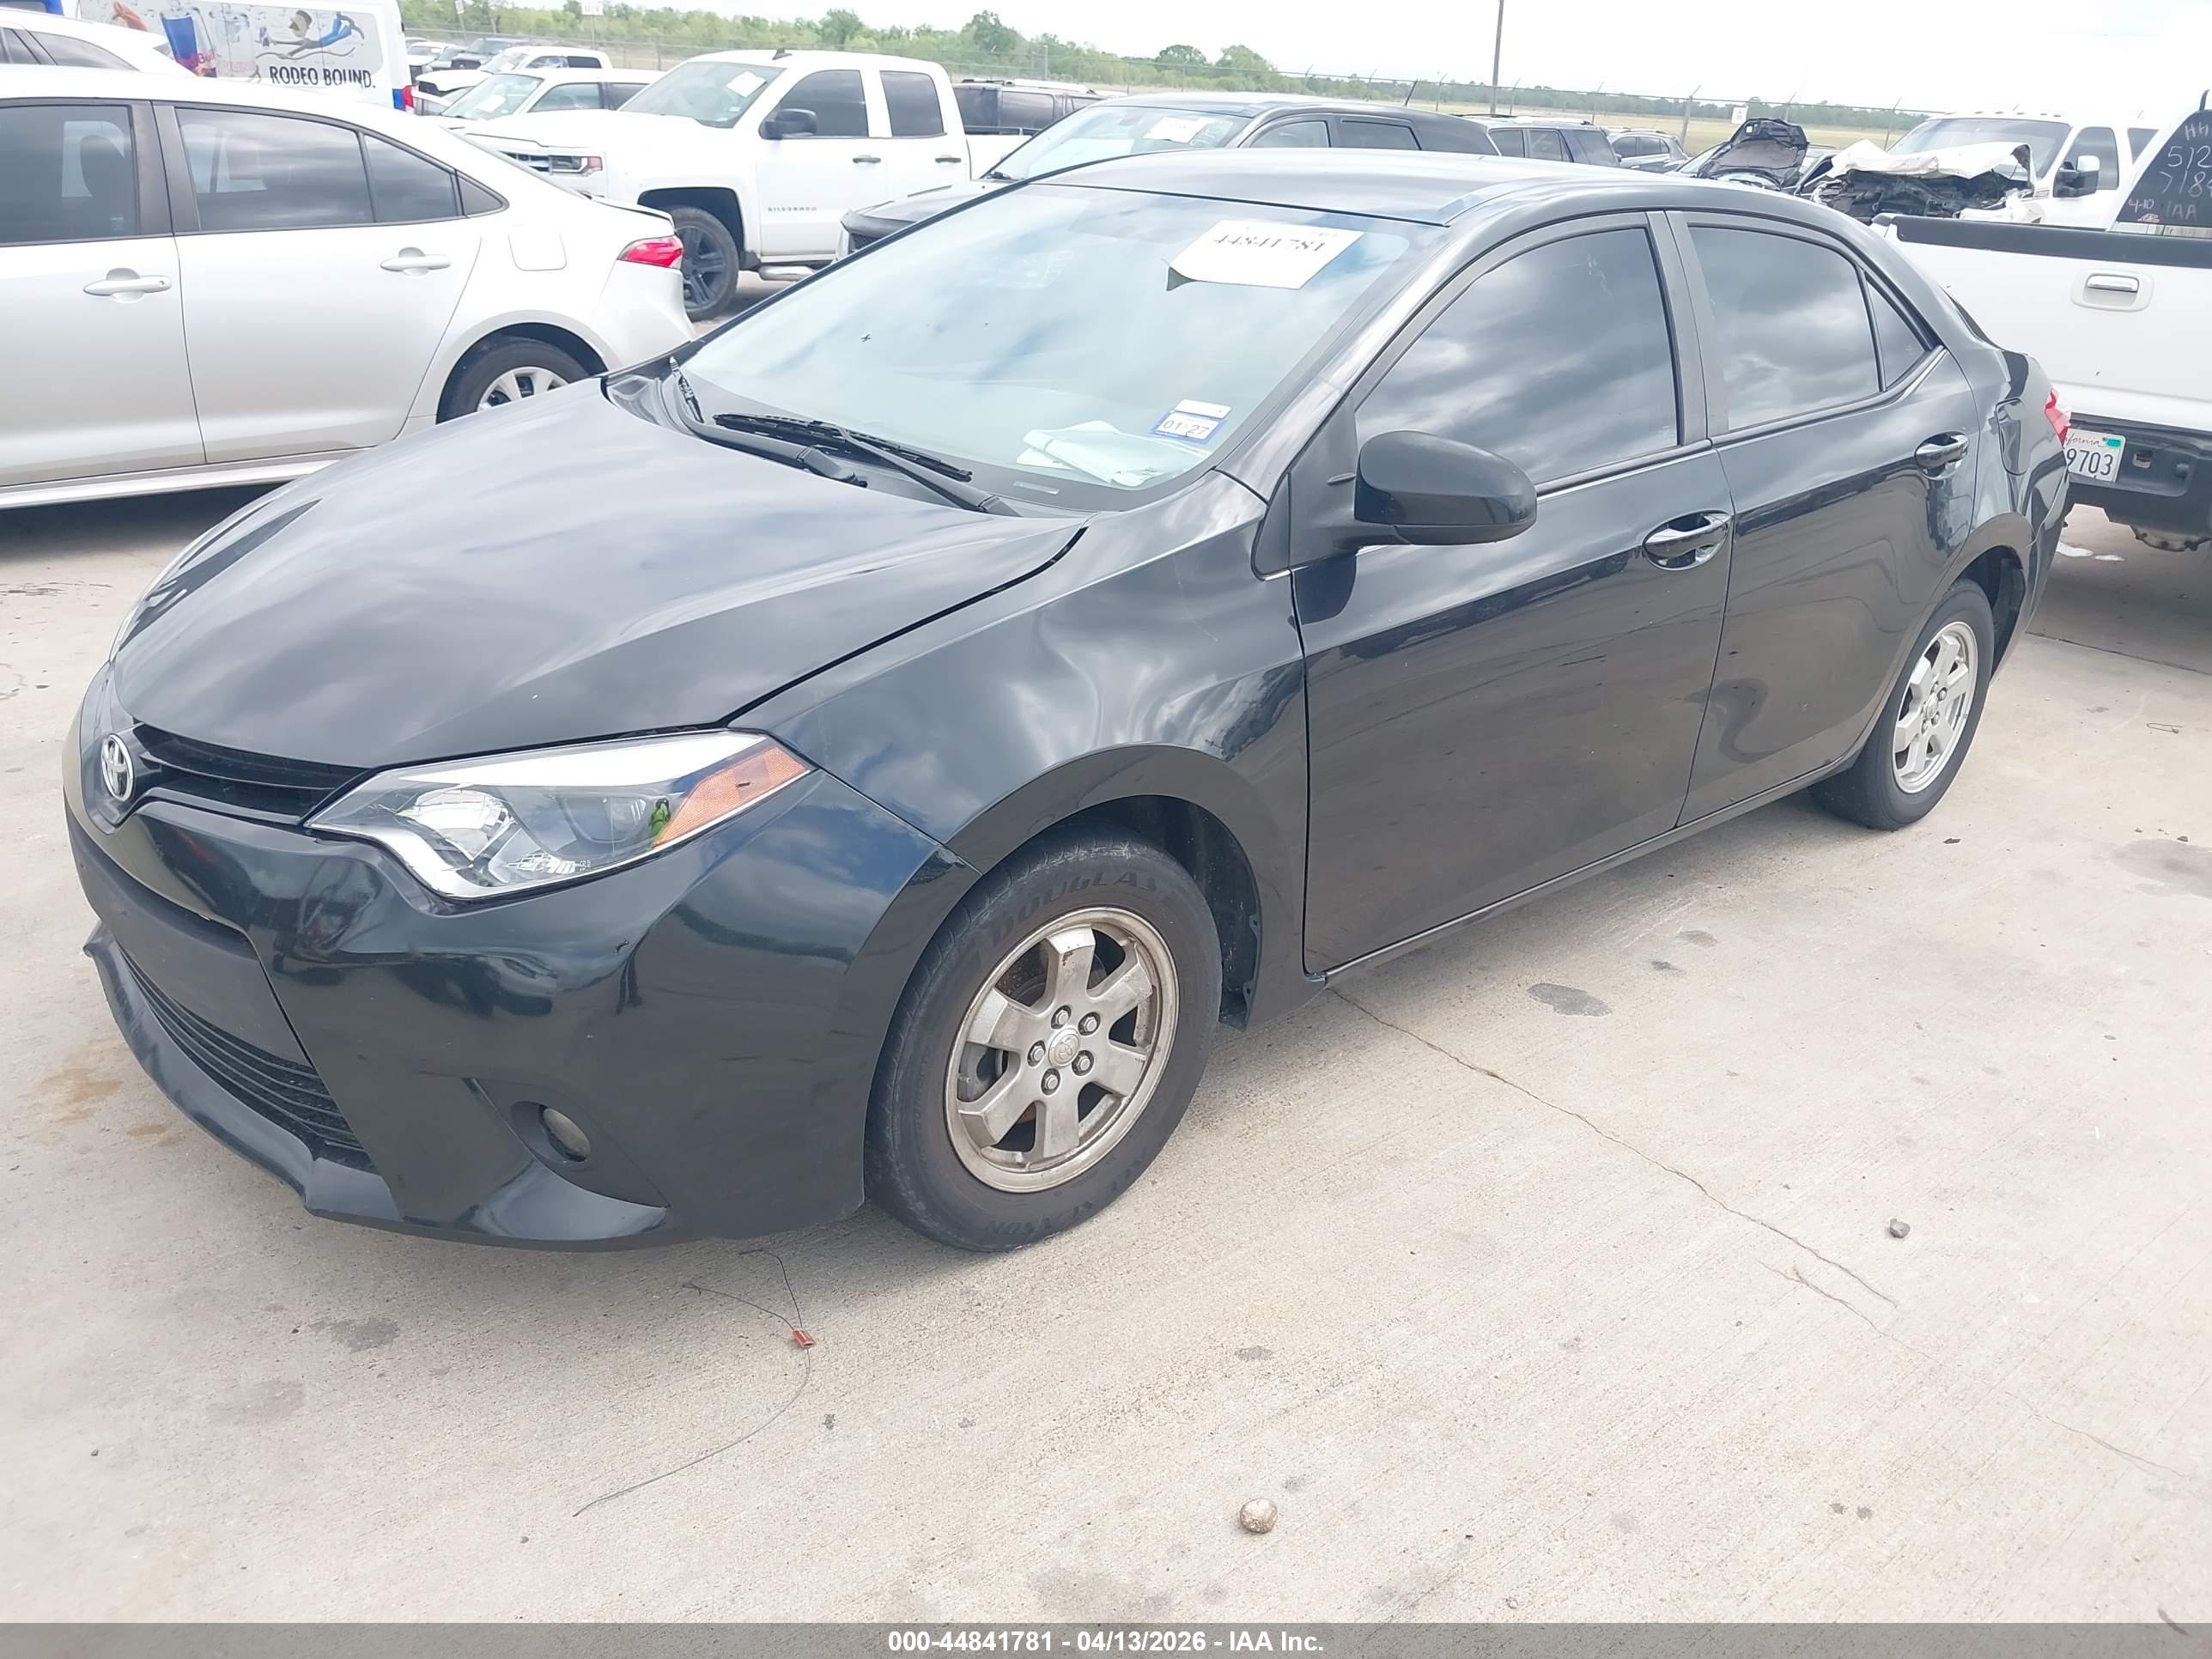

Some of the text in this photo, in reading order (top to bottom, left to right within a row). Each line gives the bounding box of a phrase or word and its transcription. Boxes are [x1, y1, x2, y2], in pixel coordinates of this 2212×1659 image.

[269, 66, 375, 88] RODEO BOUND.
[2066, 447, 2114, 476] 9703
